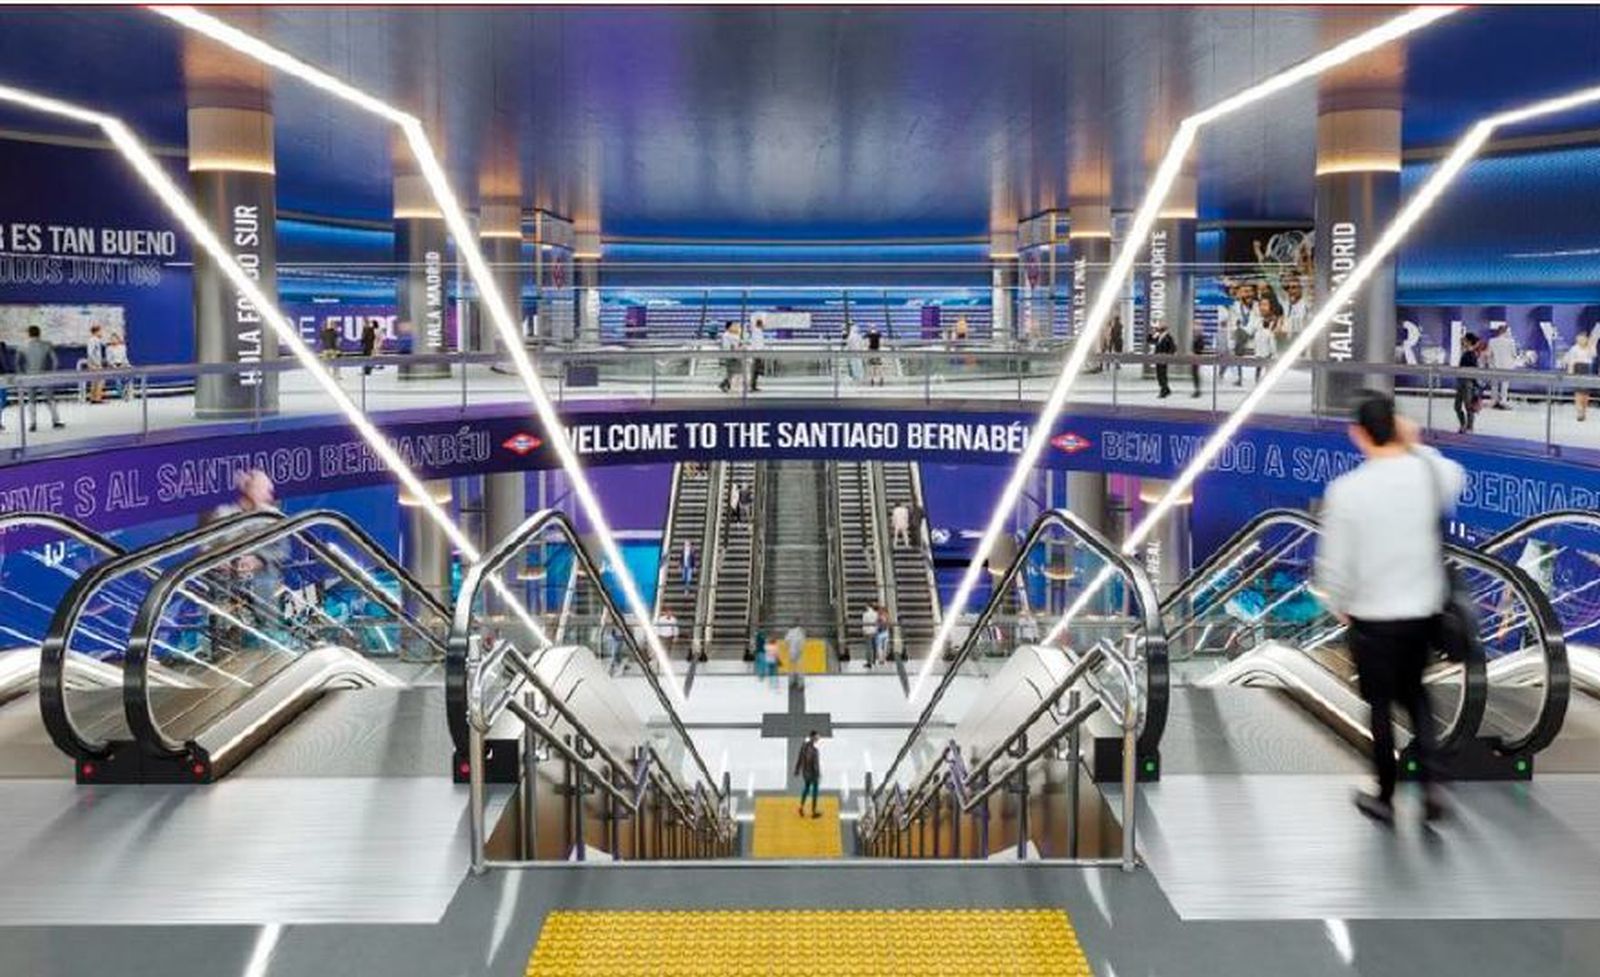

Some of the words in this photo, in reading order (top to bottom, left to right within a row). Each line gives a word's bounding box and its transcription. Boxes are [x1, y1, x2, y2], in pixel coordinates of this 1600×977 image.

[11, 223, 42, 251] ES
[48, 226, 95, 254] TAN
[102, 229, 175, 256] BUENO
[233, 205, 259, 246] SUR
[1152, 231, 1168, 277] NORTE
[425, 251, 441, 306] MADRID
[428, 310, 442, 347] HALA
[685, 422, 717, 449] TO
[724, 422, 772, 448] THE
[778, 421, 899, 449] SANTIAGO
[1101, 430, 1162, 464] BEM
[1263, 443, 1286, 479] A
[74, 476, 96, 518] S
[106, 470, 149, 511] AL
